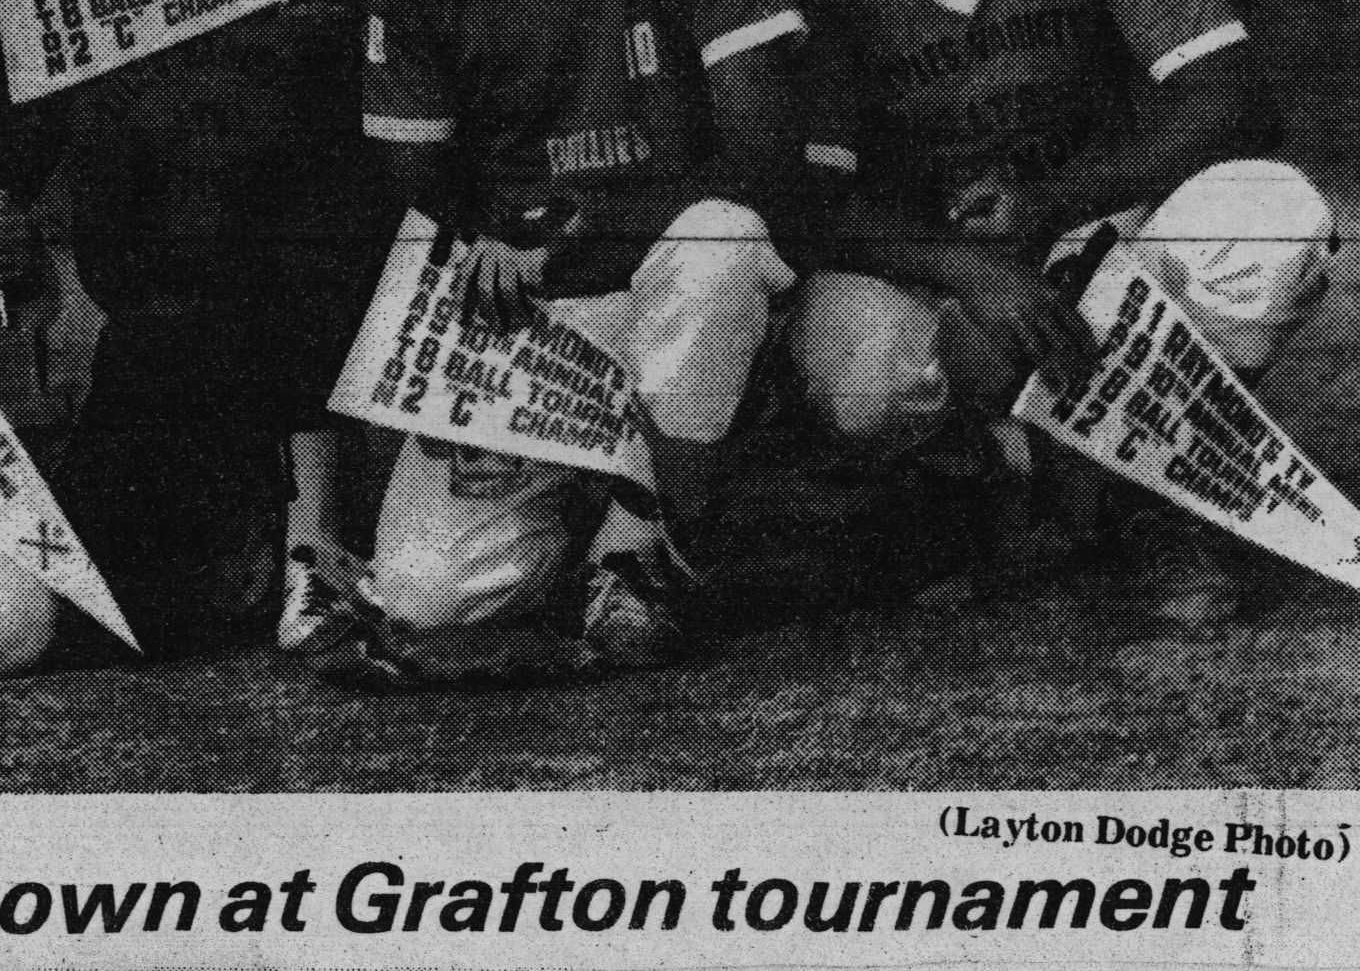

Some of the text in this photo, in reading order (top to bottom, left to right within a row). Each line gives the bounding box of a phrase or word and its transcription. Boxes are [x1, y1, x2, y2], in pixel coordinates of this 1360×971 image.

[371, 265, 440, 408] RAFTON
[528, 320, 628, 392] MOND'S
[443, 350, 514, 400] BALL
[513, 346, 617, 411] ANNUAL
[1157, 319, 1290, 469] RAYMOND'S
[510, 406, 622, 456] CHAMPS
[1123, 385, 1180, 447] BALL
